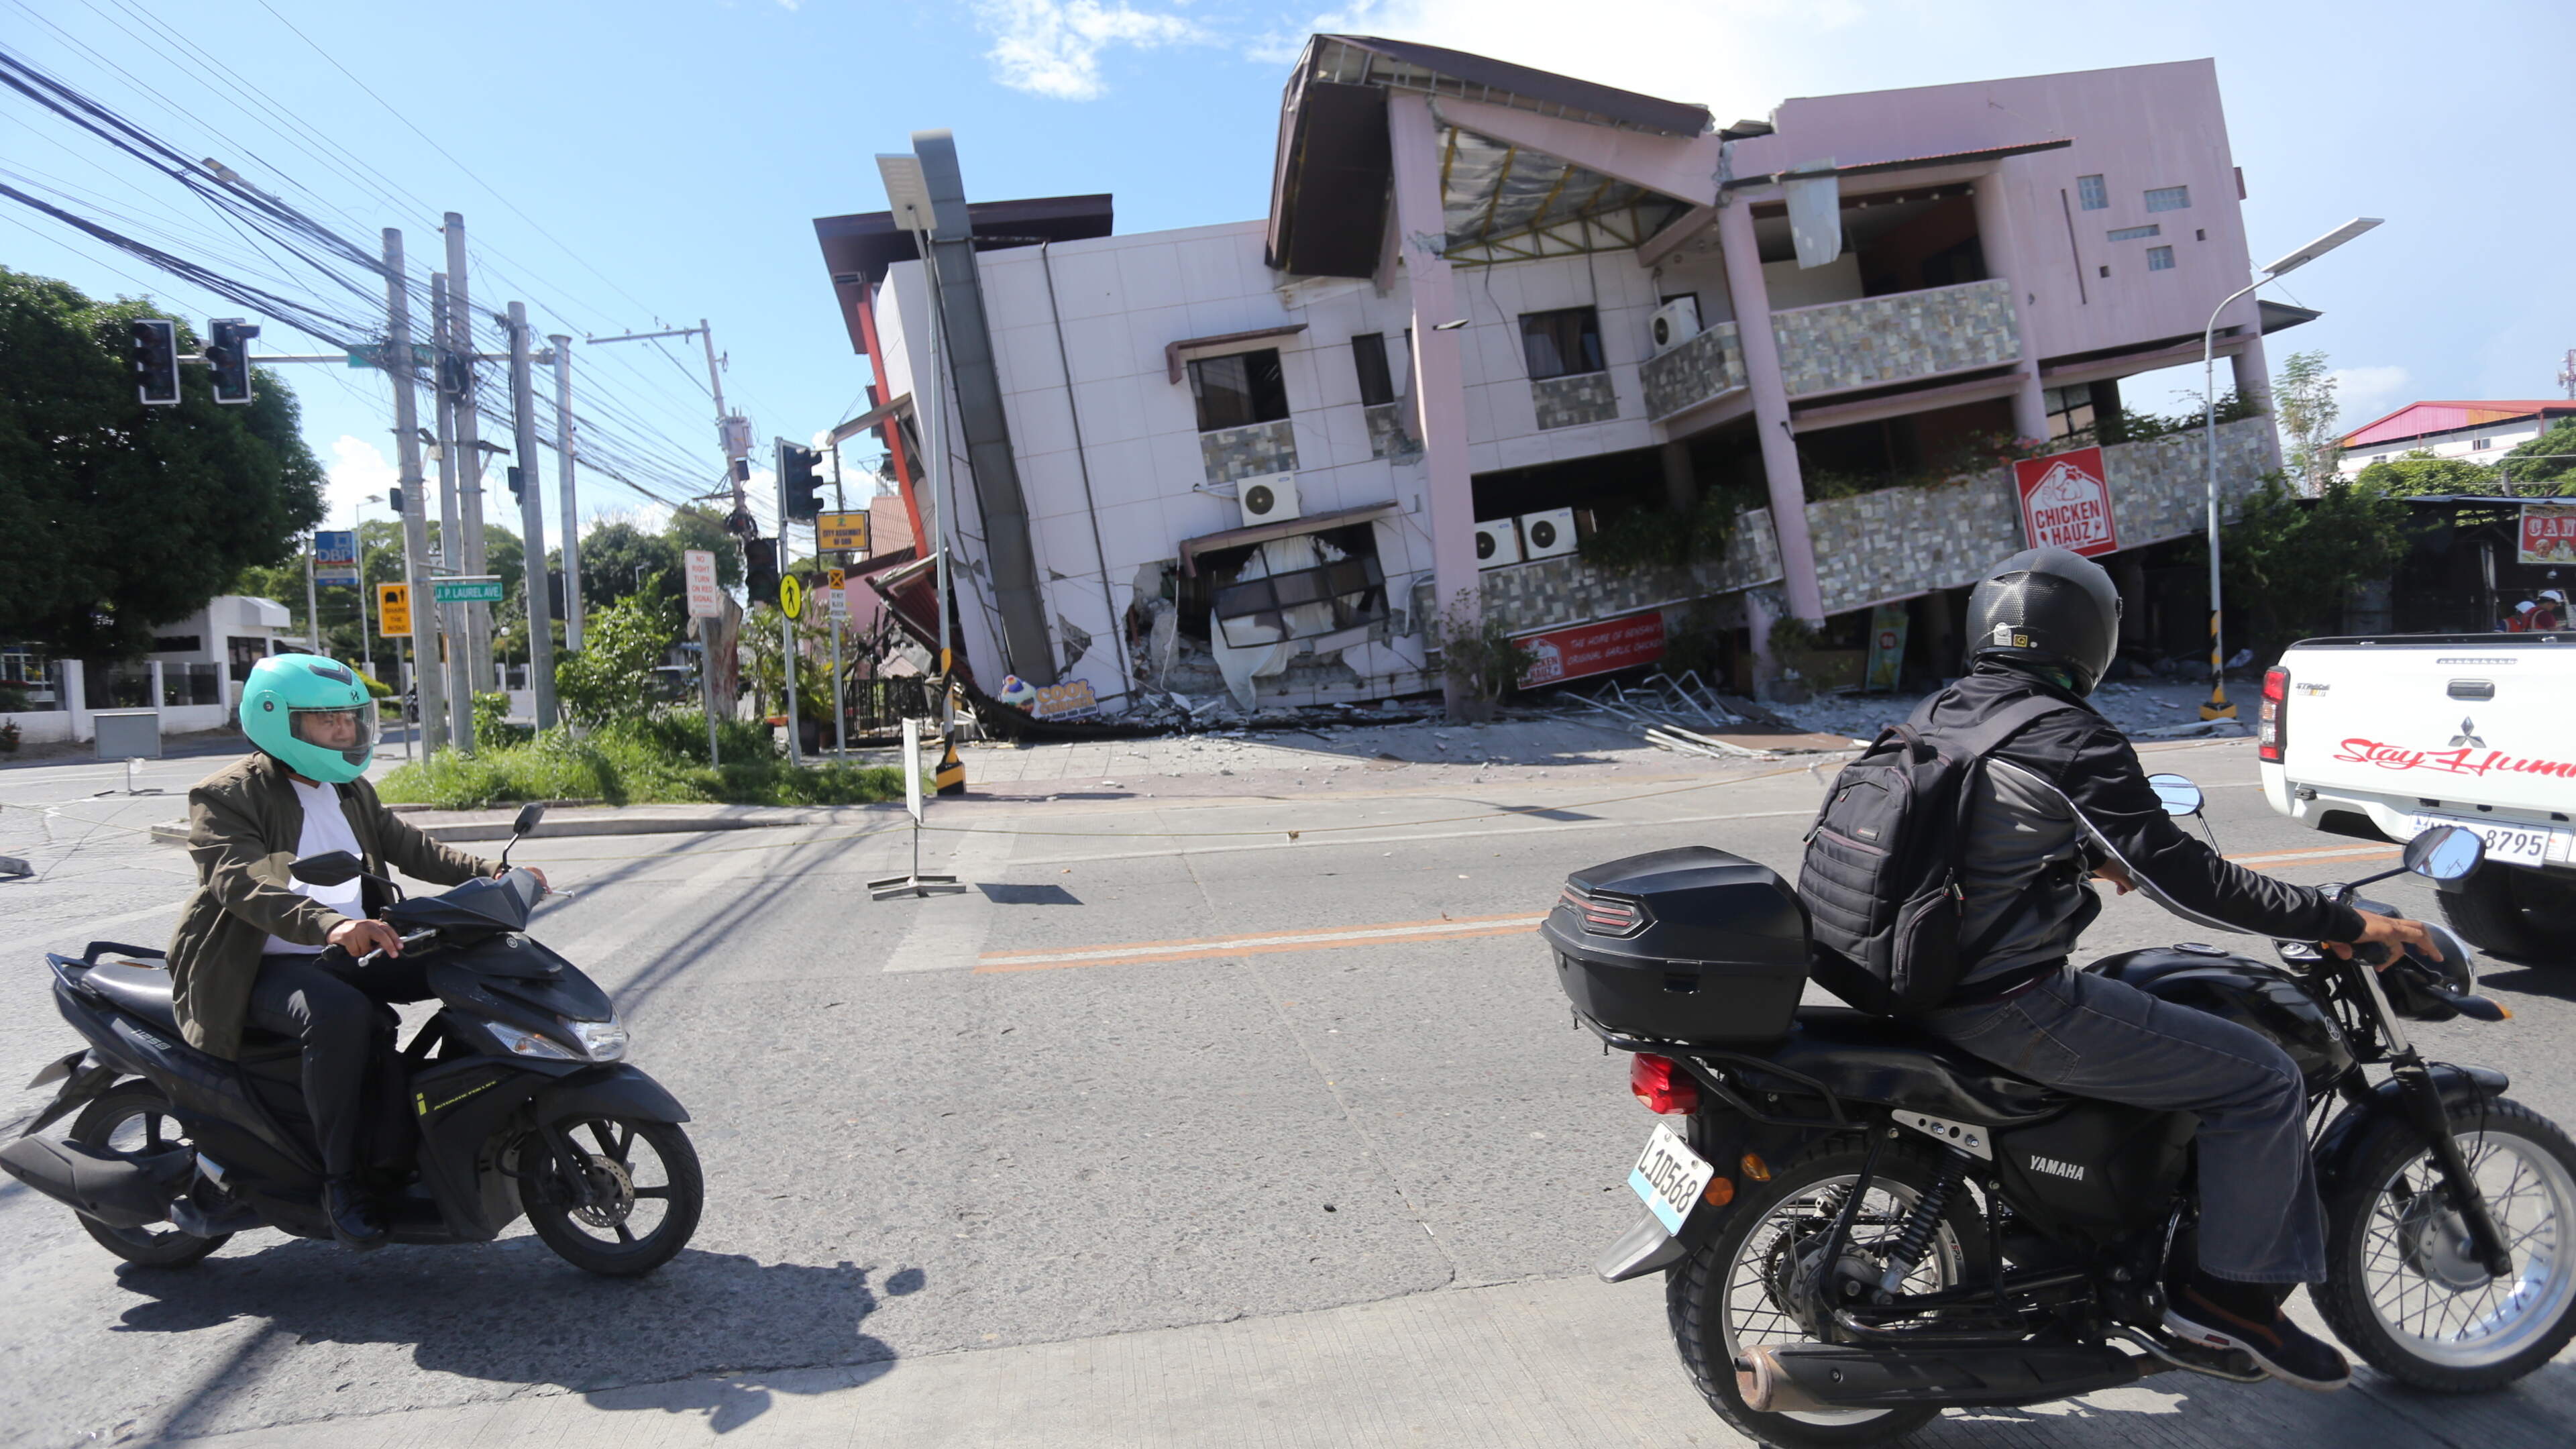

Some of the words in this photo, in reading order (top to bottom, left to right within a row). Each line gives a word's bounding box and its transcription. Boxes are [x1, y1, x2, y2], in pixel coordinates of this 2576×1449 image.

[2035, 499, 2100, 529] CHICKEN
[2051, 521, 2092, 546] HAUZ
[317, 549, 352, 562] DBP
[692, 565, 710, 574] RIGHT
[693, 575, 710, 583] TURN
[436, 588, 443, 598] J.
[444, 588, 451, 598] P.
[452, 586, 483, 598] LAUREL
[693, 595, 714, 603] SIGNAL
[702, 586, 713, 594] RED
[1036, 680, 1094, 703] COOL
[2332, 738, 2426, 771] Stay
[2484, 829, 2544, 856] 8795
[2030, 1155, 2085, 1181] YAMAHA
